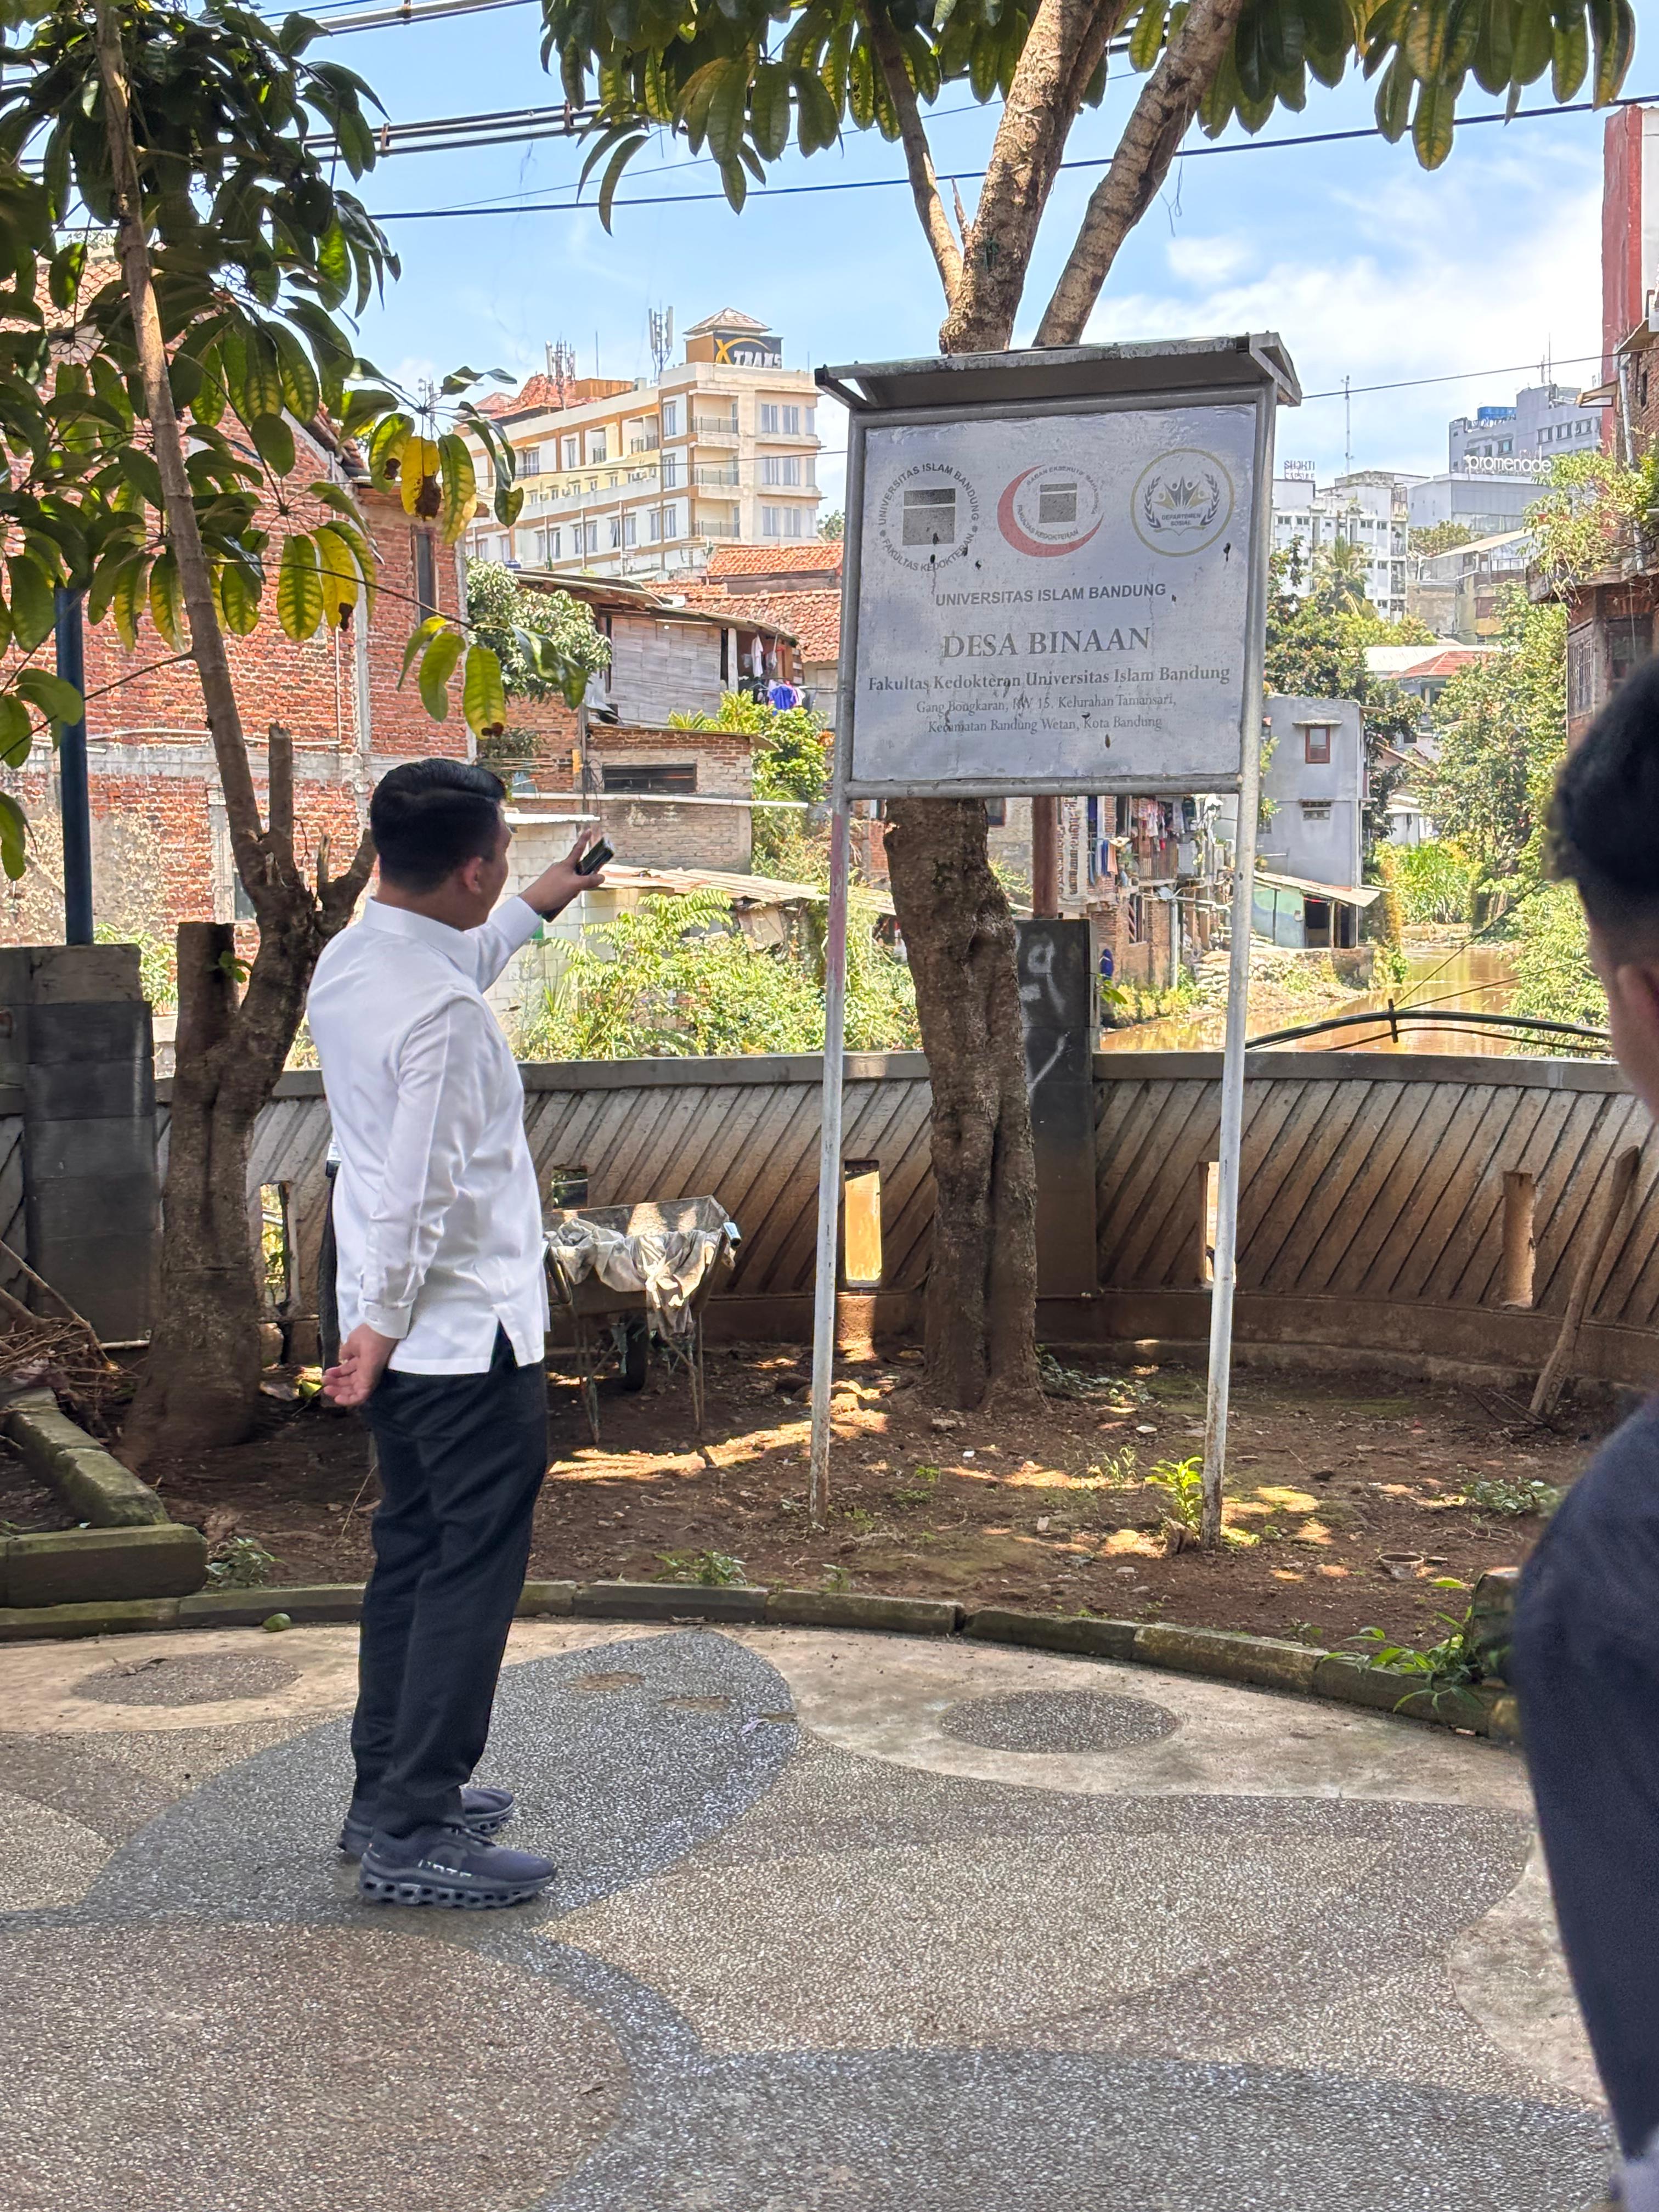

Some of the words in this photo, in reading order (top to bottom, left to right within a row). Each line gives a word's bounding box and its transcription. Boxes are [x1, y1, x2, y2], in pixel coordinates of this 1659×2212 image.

[1468, 445, 1552, 474] promenade
[878, 466, 920, 526] UNIVERSITAS
[922, 463, 953, 476] ISLAM
[953, 471, 979, 522] BANDUNG
[882, 538, 919, 571] FAKULTAS
[920, 533, 975, 572] KEDOKTERAN
[936, 590, 1033, 606] UNIVERSITAS
[1038, 588, 1084, 602] ISLAM
[1088, 583, 1166, 599] BANDUNG
[942, 633, 1018, 658] DESA
[1028, 627, 1151, 655] BINAAN
[868, 676, 929, 691] Fakultas
[934, 673, 1021, 690] Kedokteran
[1026, 670, 1109, 686] Universitas
[1114, 668, 1154, 682] Islam
[1159, 665, 1230, 685] Bandung
[916, 701, 945, 717] Gang
[949, 698, 1009, 716] Bongkaran,
[1058, 695, 1114, 709] Kelurahan
[1115, 693, 1176, 707] Tamansari,
[990, 718, 1037, 735] Bandung
[1042, 717, 1080, 731] Wetan,
[1084, 716, 1110, 730] Kota
[1114, 714, 1162, 731] Bandung
